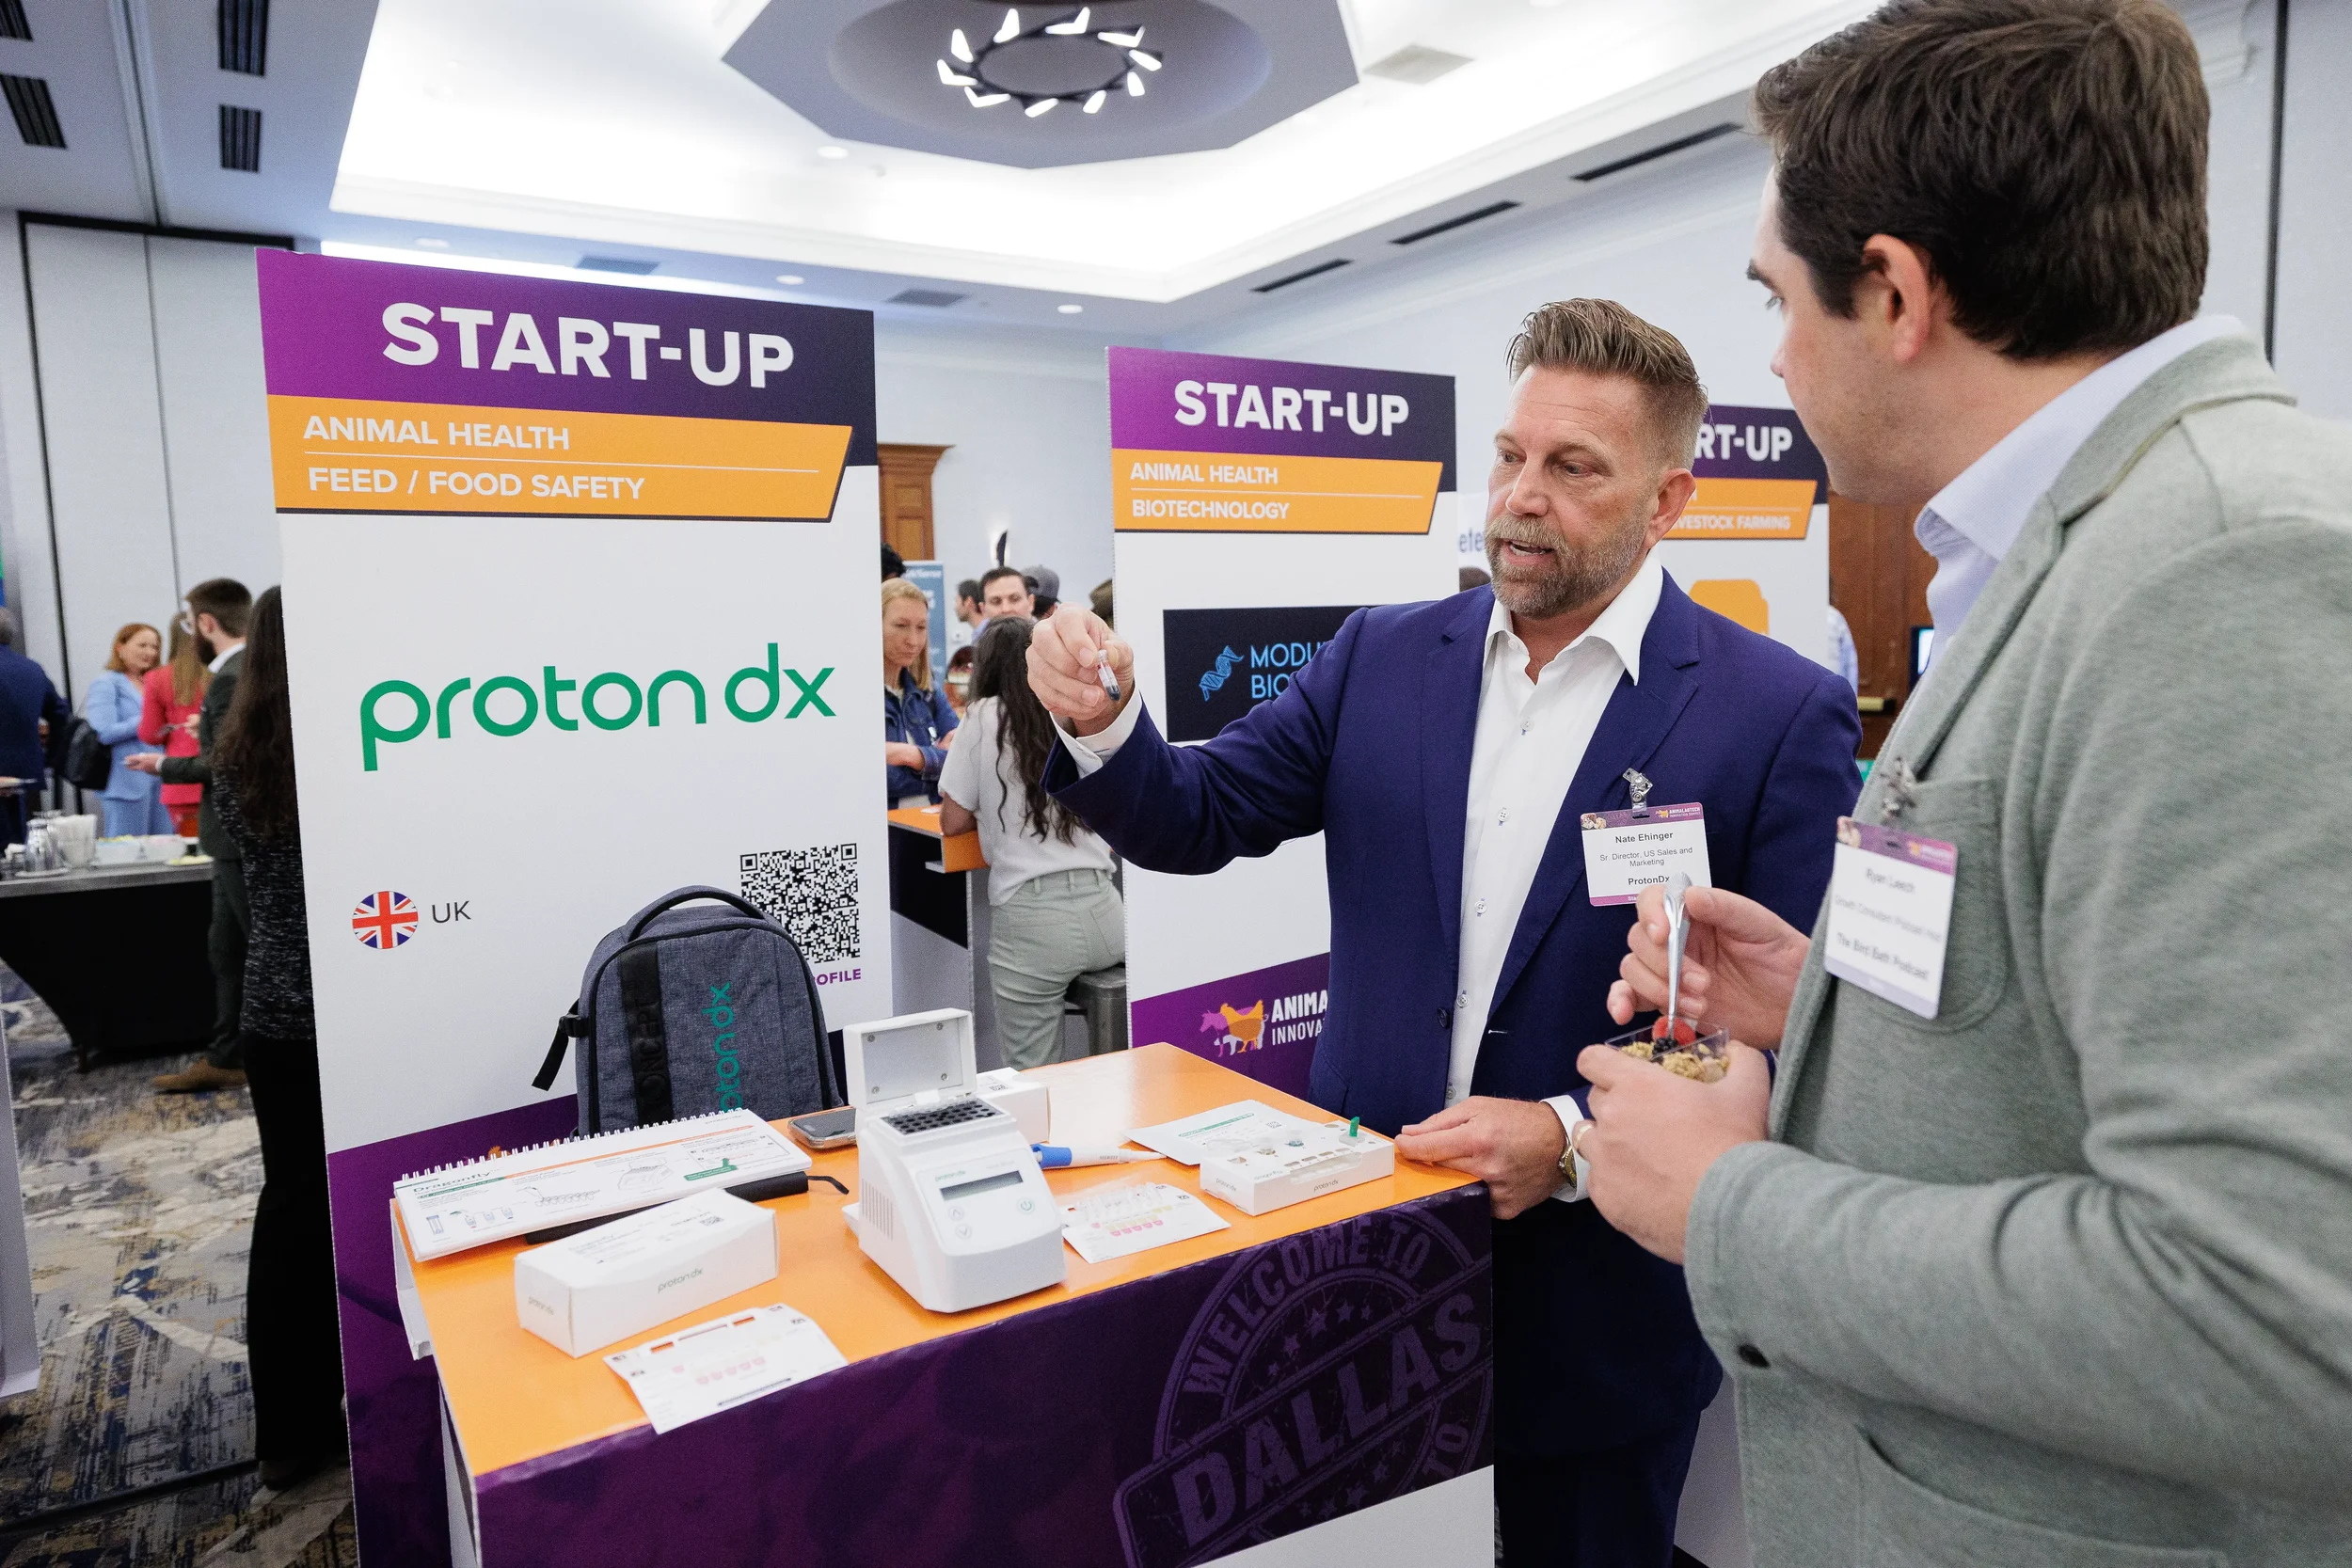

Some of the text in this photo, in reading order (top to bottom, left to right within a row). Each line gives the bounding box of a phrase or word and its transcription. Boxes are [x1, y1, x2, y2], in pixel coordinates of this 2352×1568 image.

[381, 302, 794, 388] START-UP
[1174, 380, 1409, 436] START-UP
[303, 415, 570, 451] ANIMAL HEALTH
[309, 467, 645, 500] FEED / FOOD SAFETY
[1130, 462, 1279, 484] ANIMAL HEALTH
[1132, 499, 1290, 519] BIOTECHNOLOGY
[1674, 515, 1791, 531] VESTOCK FARMING
[1250, 641, 1326, 668] MODU
[360, 642, 836, 771] proton dx
[1615, 832, 1674, 844] Nate Ehinger
[1629, 858, 1665, 868] Marketing
[1644, 849, 1655, 858] US
[1657, 848, 1677, 857] Sales
[1679, 847, 1692, 855] and
[431, 900, 471, 924] UK
[813, 968, 862, 986] OFILE
[701, 981, 735, 1028] dx
[1272, 1018, 1326, 1046] INNOVA
[413, 1172, 491, 1193] Dragonfly
[1313, 1181, 1332, 1193] proton
[658, 1267, 704, 1294] proton dx
[1183, 1213, 1431, 1394] WELCOME TO
[1171, 1293, 1481, 1548] DALLAS
